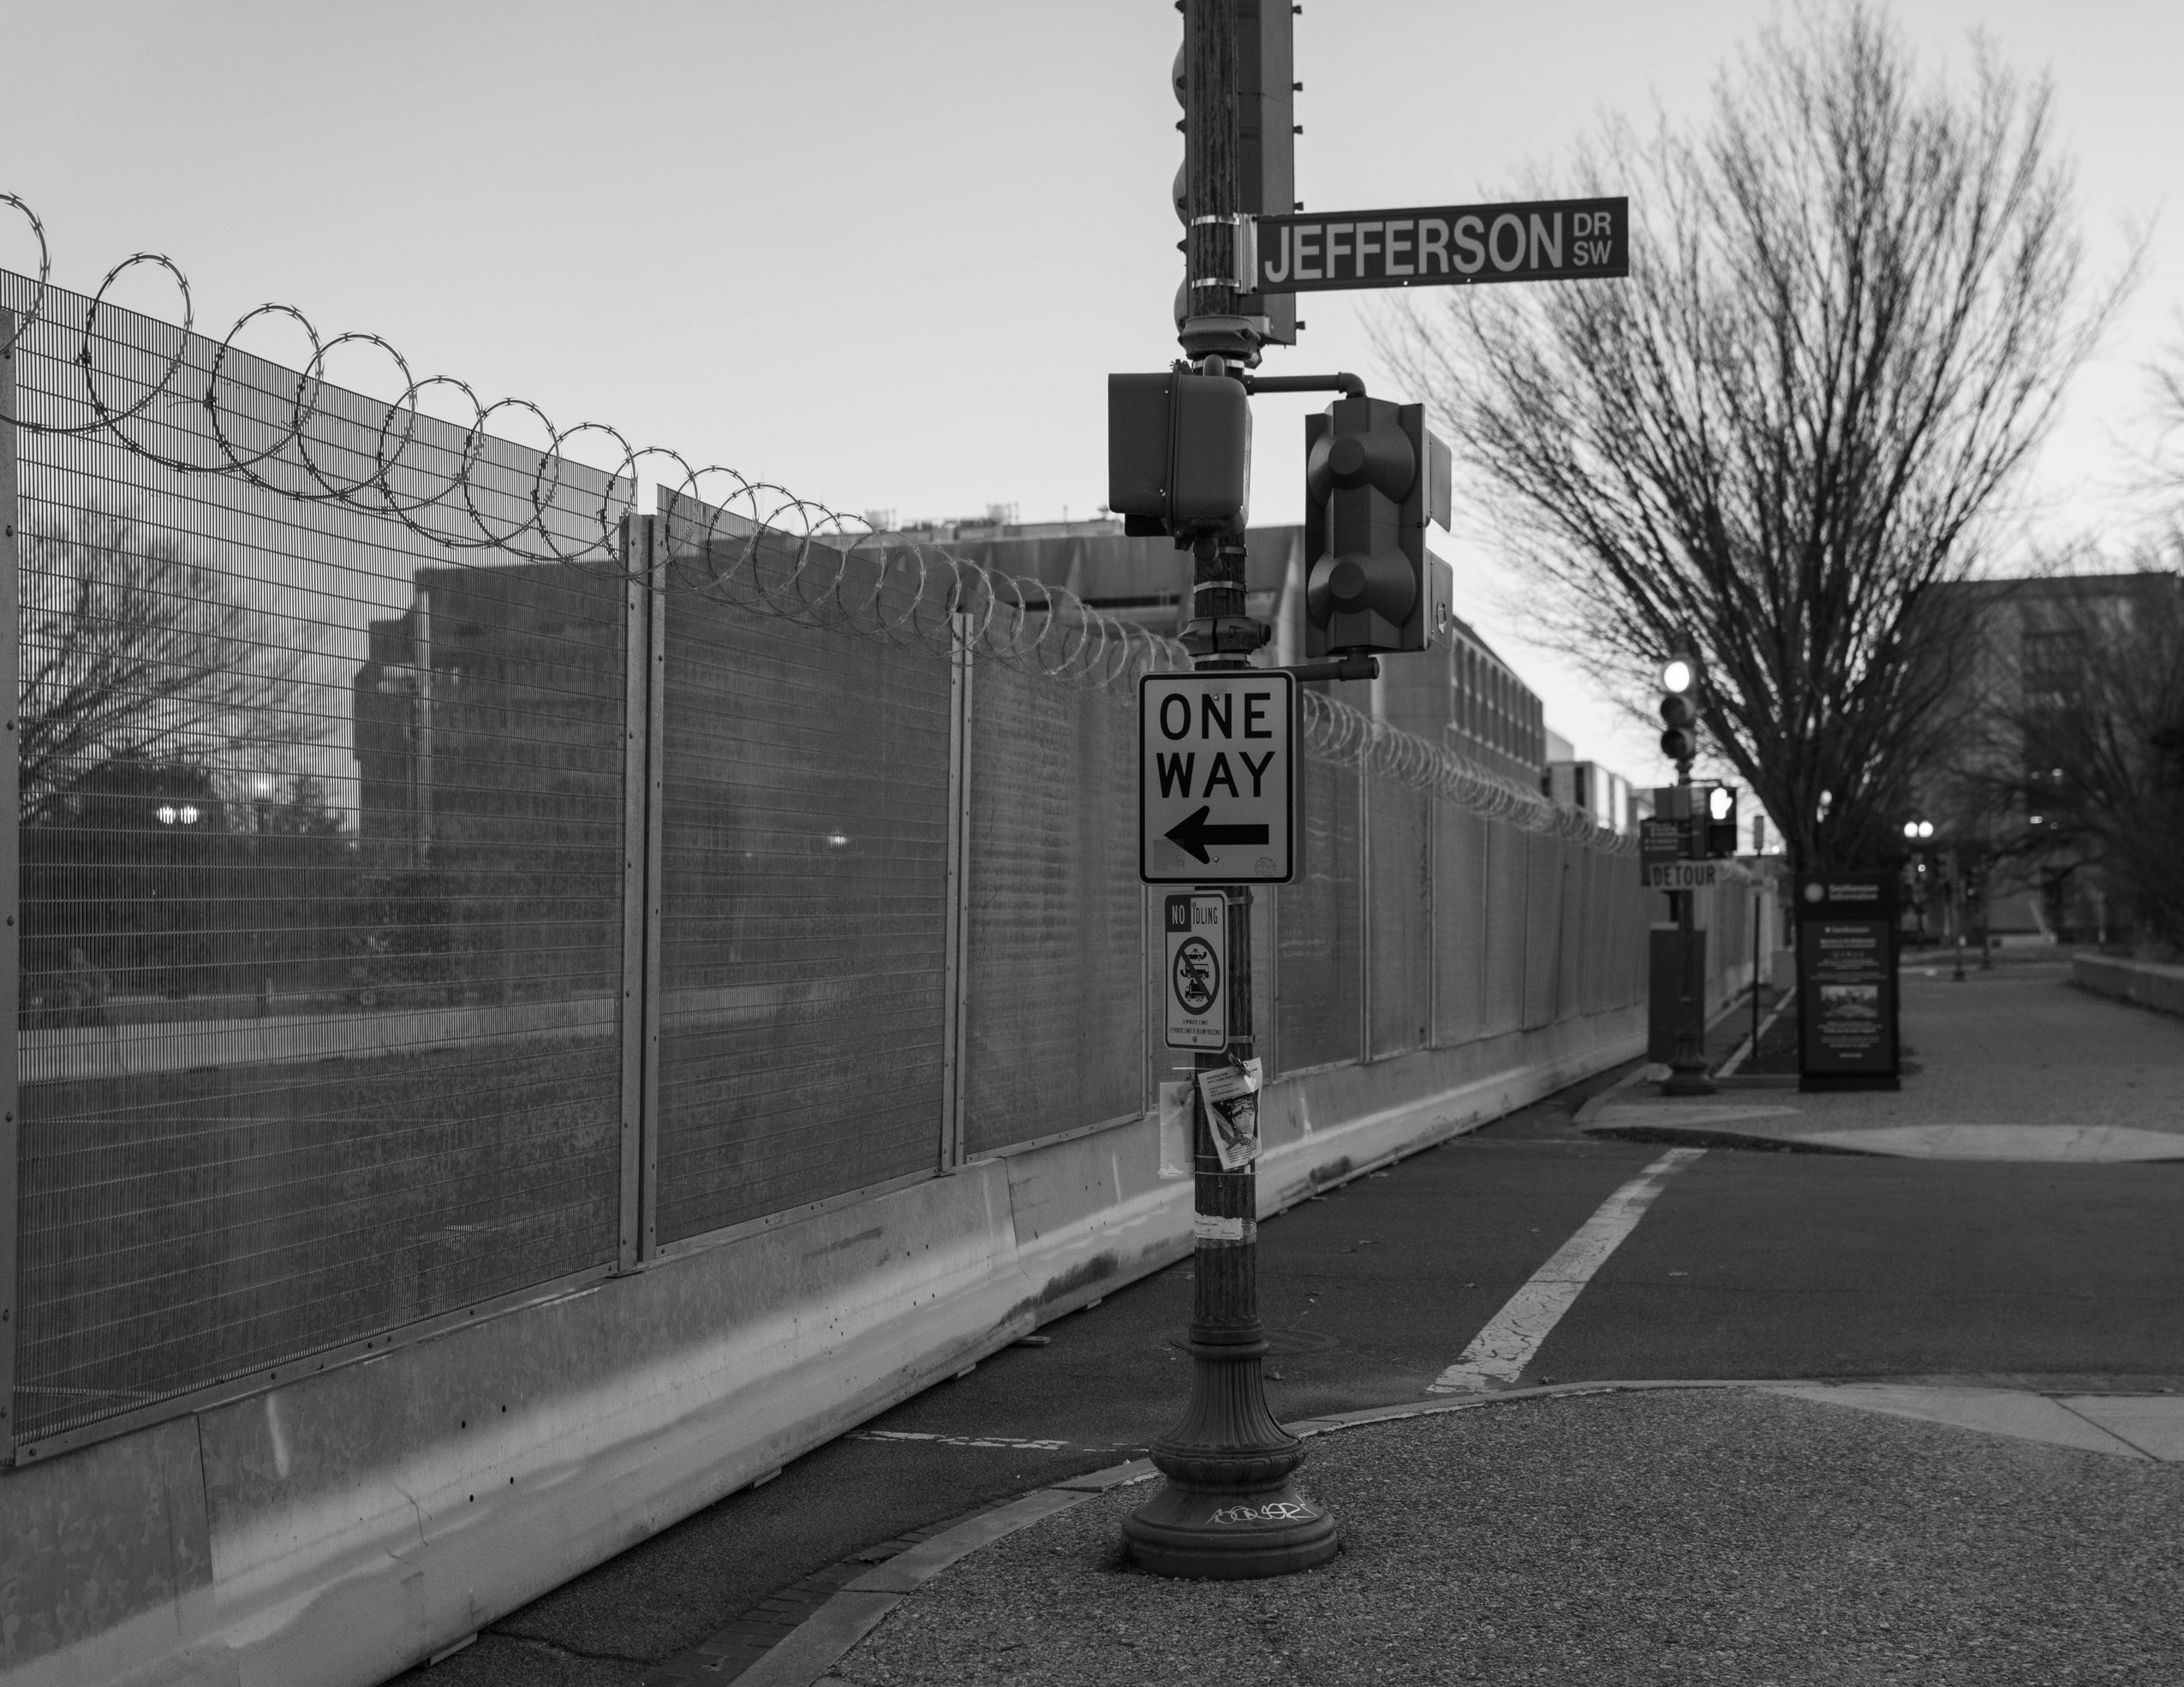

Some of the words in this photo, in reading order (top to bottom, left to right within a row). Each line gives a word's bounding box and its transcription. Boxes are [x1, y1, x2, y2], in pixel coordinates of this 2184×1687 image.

[1264, 212, 1563, 283] JEFFERSON
[1573, 212, 1611, 238] DR
[1572, 240, 1613, 267] SW
[1160, 692, 1273, 741] ONE
[1156, 751, 1276, 799] WAY
[1652, 865, 1716, 886] DETOUR
[1172, 904, 1185, 925] NO
[1192, 906, 1218, 925] IDLING
